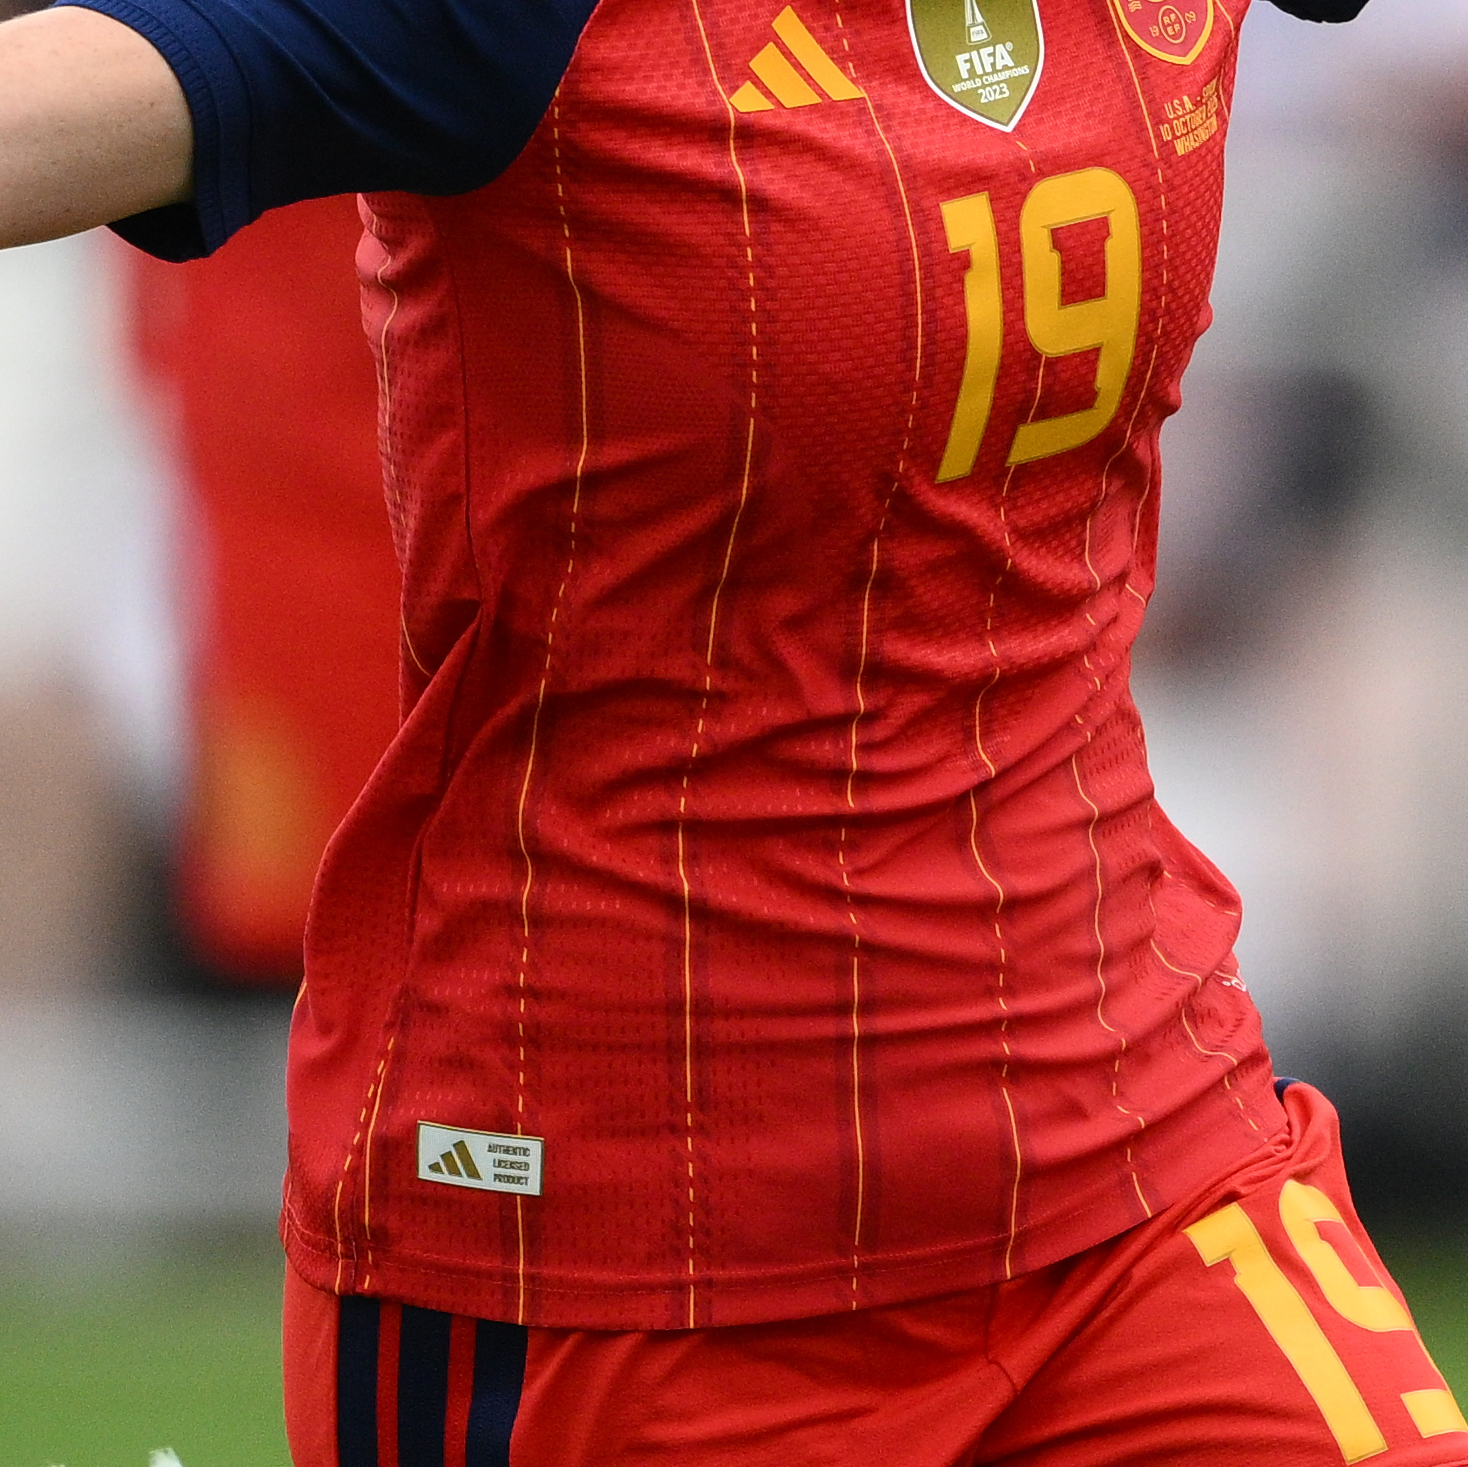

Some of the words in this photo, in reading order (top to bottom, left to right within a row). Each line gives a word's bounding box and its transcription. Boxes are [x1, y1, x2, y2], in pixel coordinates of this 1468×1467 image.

[956, 44, 1014, 79] FIFA
[952, 78, 982, 93] WORLD
[983, 65, 1030, 84] CHAMPIONS
[977, 83, 1010, 103] 2023
[1159, 123, 1173, 141] 10
[935, 167, 1142, 484] 19
[487, 1143, 531, 1157] AUTHENTIC
[492, 1158, 530, 1172] LICENSED
[493, 1173, 530, 1186] PRODUCT
